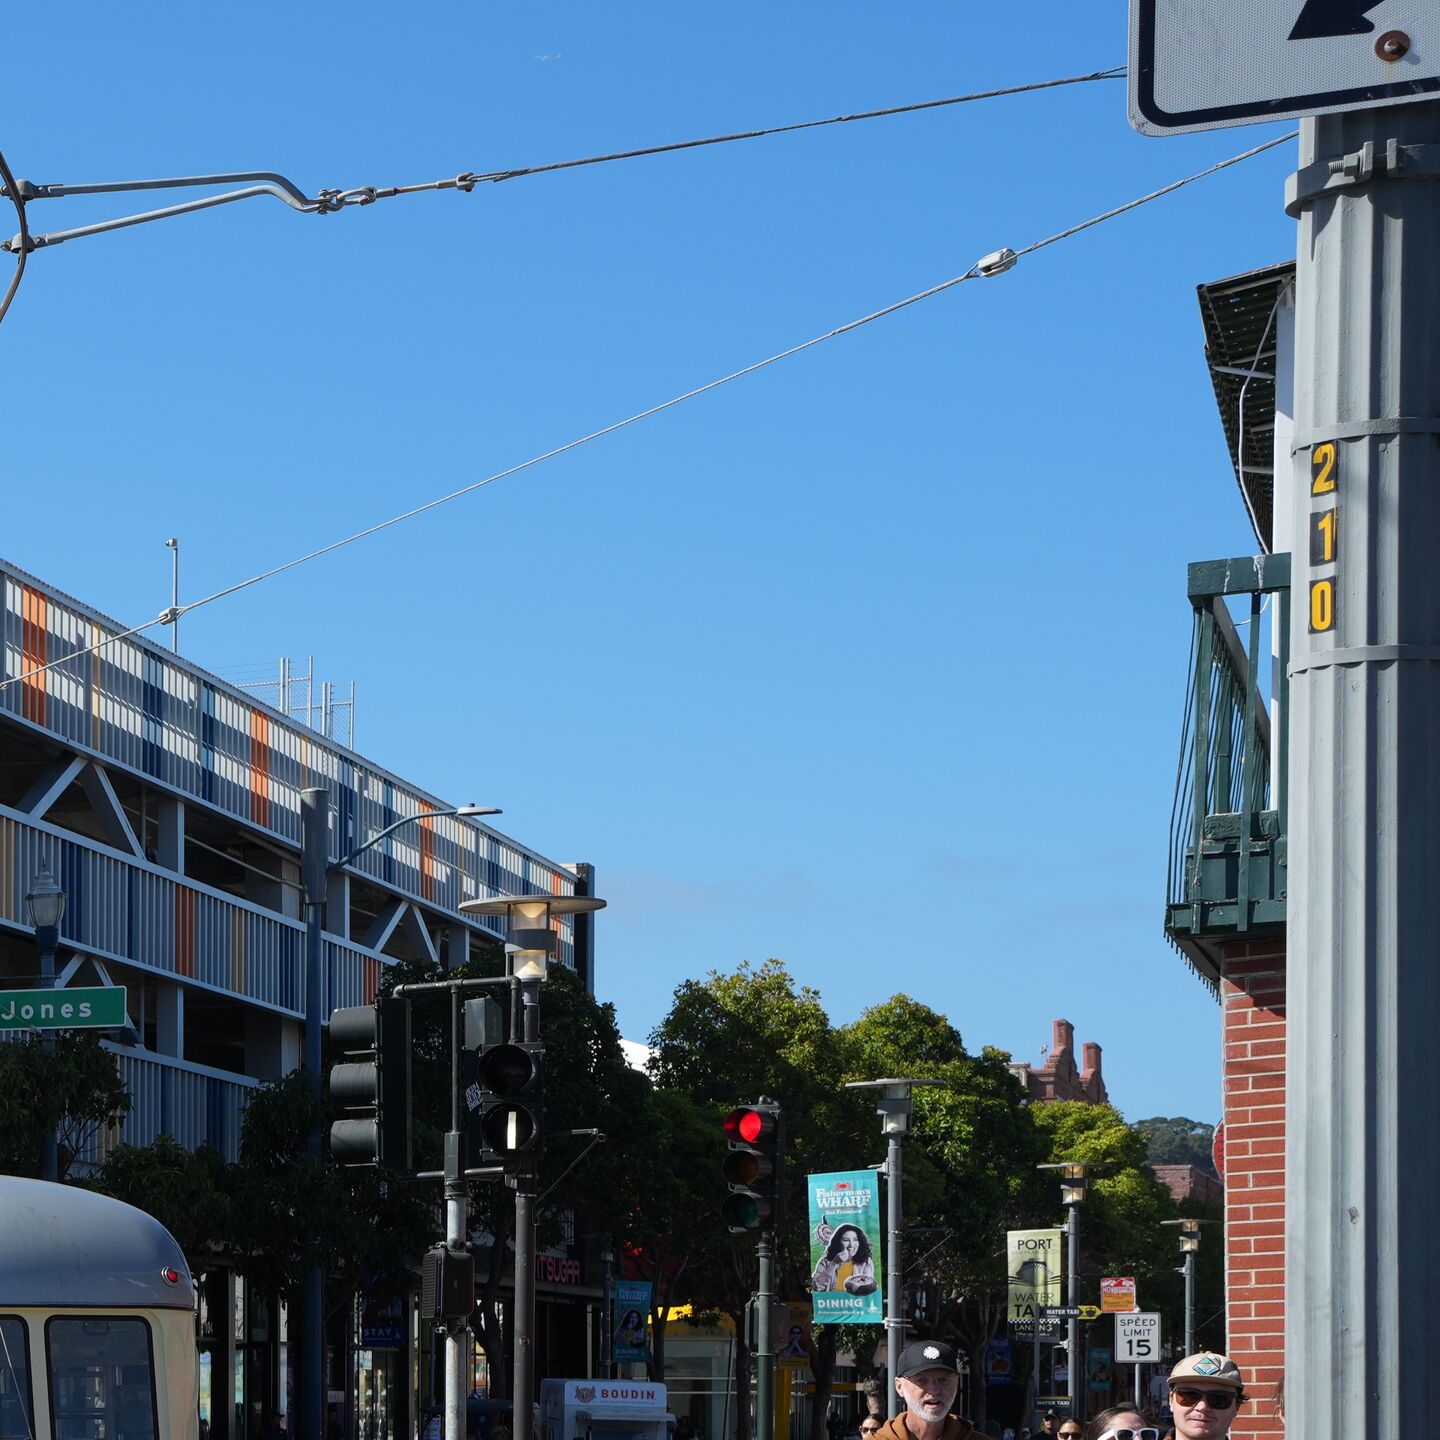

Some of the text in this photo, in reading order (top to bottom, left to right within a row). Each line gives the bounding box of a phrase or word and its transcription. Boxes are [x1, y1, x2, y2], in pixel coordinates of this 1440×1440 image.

[1312, 443, 1336, 630] 210
[1, 1001, 92, 1020] Jones
[816, 1196, 871, 1208] WHARF
[1018, 1239, 1052, 1250] PORT
[1015, 1293, 1054, 1302] WATER
[818, 1299, 863, 1308] DINING
[1014, 1304, 1045, 1318] TA
[1120, 1319, 1156, 1327] SPEED
[364, 1328, 391, 1337] STAY
[1126, 1339, 1151, 1356] 15
[601, 1389, 655, 1400] BOUDIN
